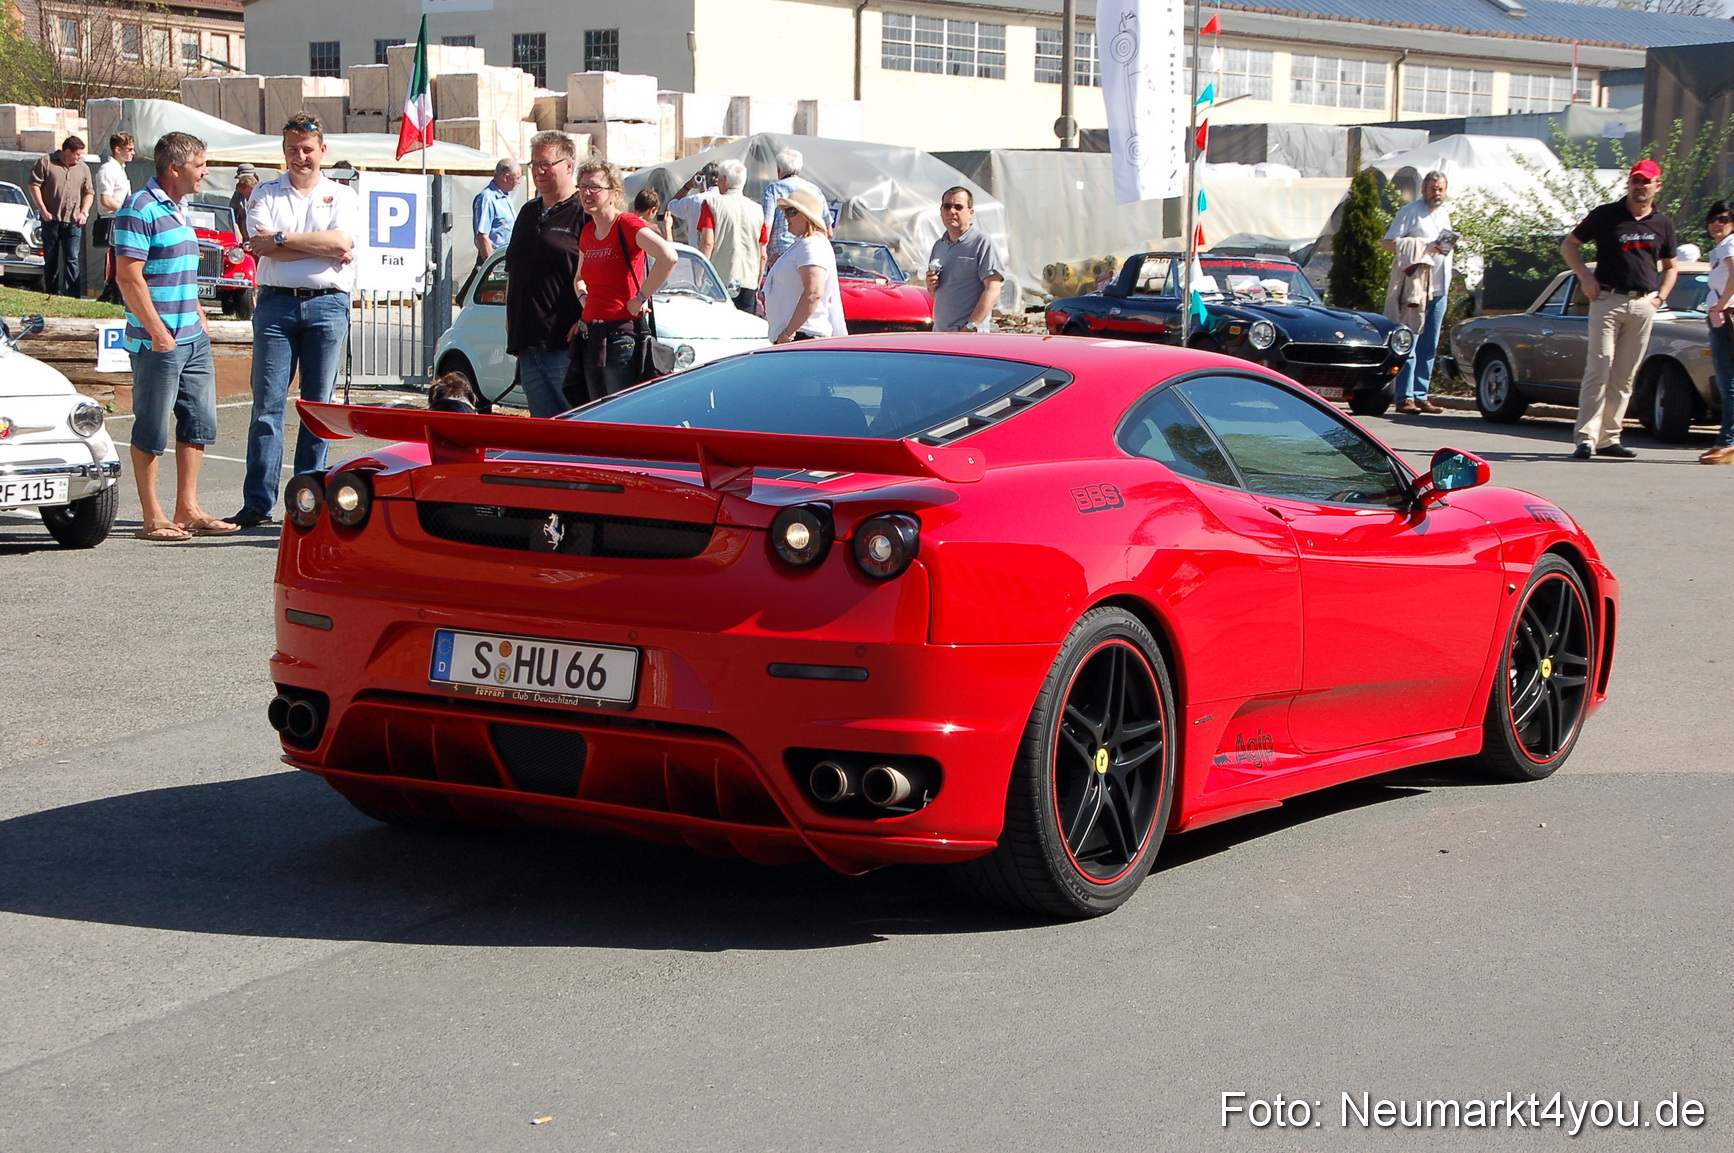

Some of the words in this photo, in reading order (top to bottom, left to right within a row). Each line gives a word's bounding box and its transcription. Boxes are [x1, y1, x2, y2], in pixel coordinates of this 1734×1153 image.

[377, 195, 410, 244] P
[381, 254, 405, 266] Fiat
[107, 330, 120, 348] P
[21, 479, 55, 502] 115
[1070, 483, 1125, 514] BBS
[438, 661, 446, 673] D
[471, 641, 493, 679] S
[513, 645, 559, 687] HU
[564, 651, 608, 692] 66
[475, 686, 505, 698] Ferrari
[512, 691, 529, 701] Club
[533, 693, 579, 706] Deutschland
[1235, 728, 1274, 769] Agip
